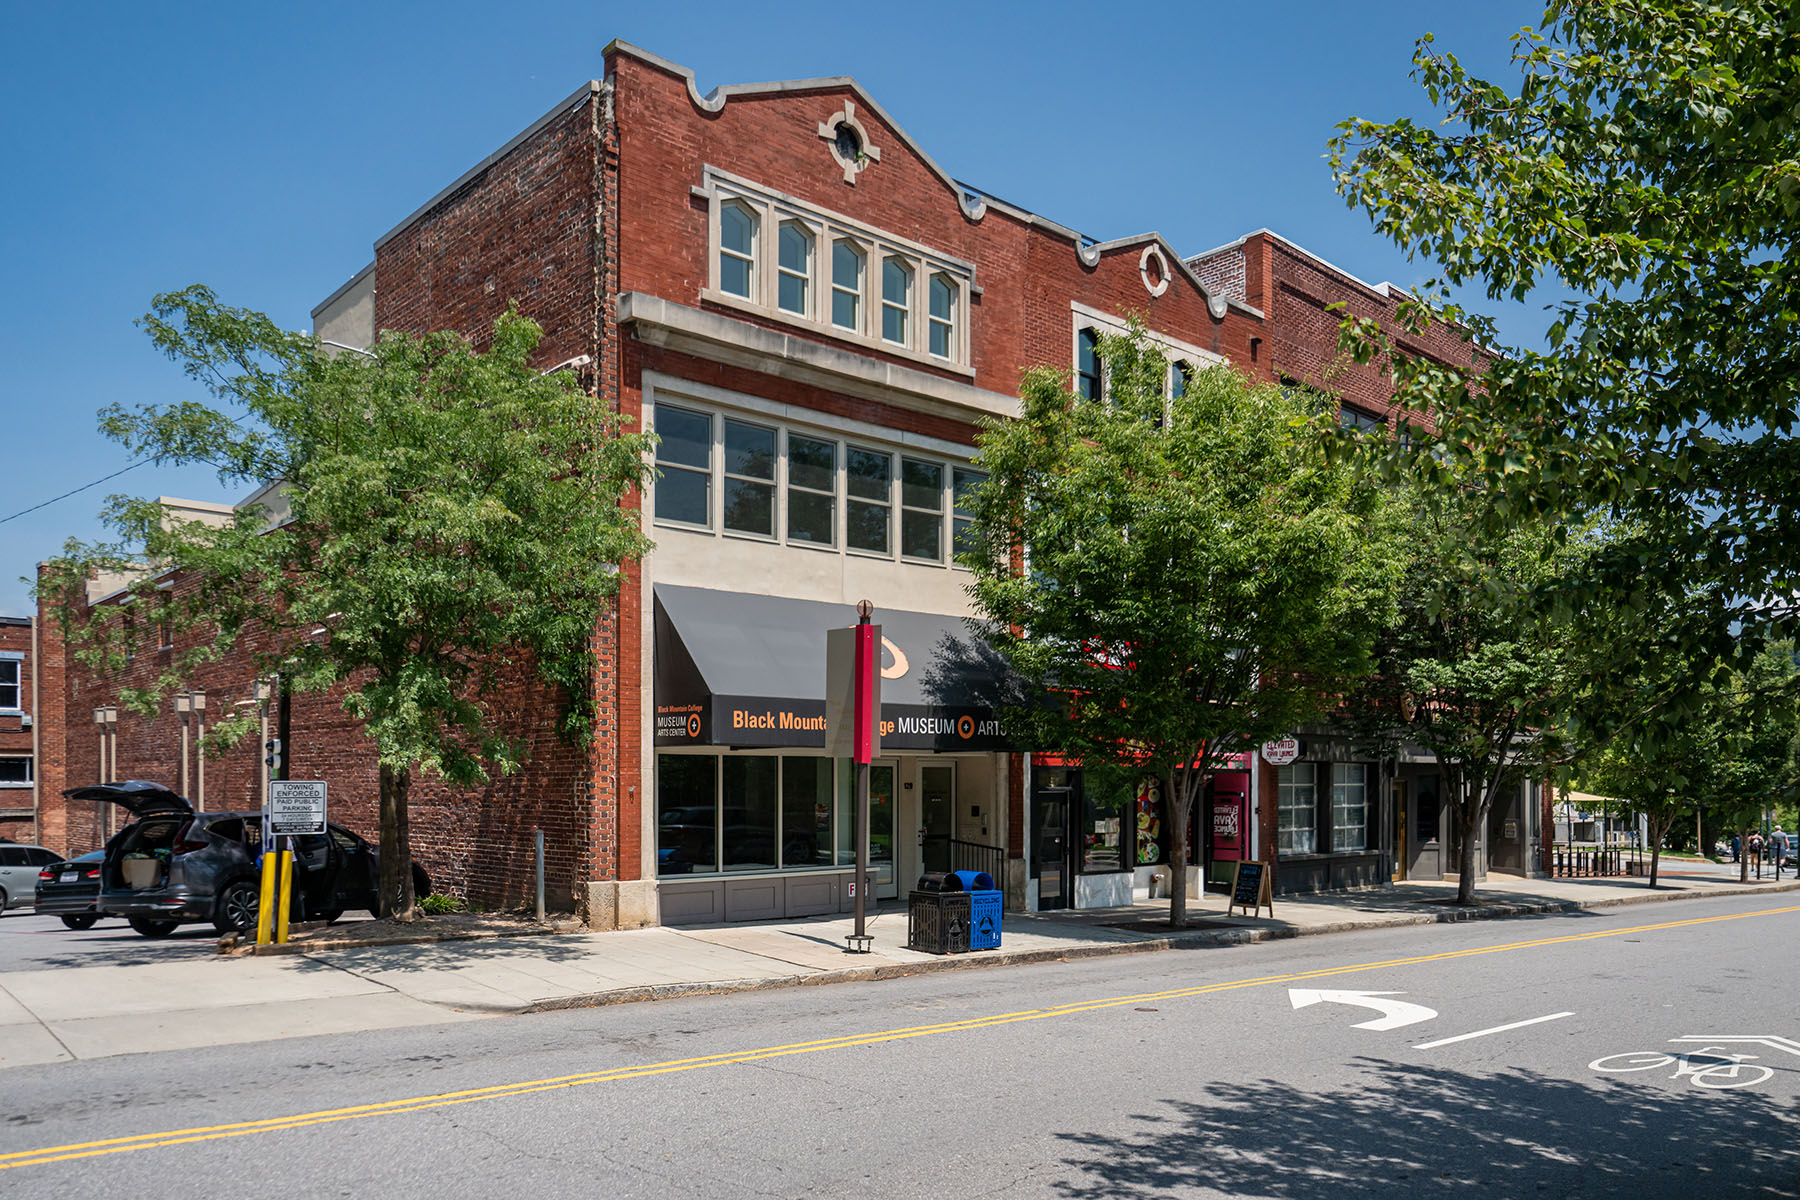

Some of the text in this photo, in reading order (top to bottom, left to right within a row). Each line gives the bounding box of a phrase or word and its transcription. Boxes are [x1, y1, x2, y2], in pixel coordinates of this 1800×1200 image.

[688, 704, 703, 712] College
[657, 716, 687, 727] MUSEUM
[733, 710, 776, 729] Black
[779, 711, 827, 731] Mount
[669, 728, 686, 736] CENTER
[898, 718, 955, 735] MUSEUM
[1266, 740, 1295, 751] ELEVATED
